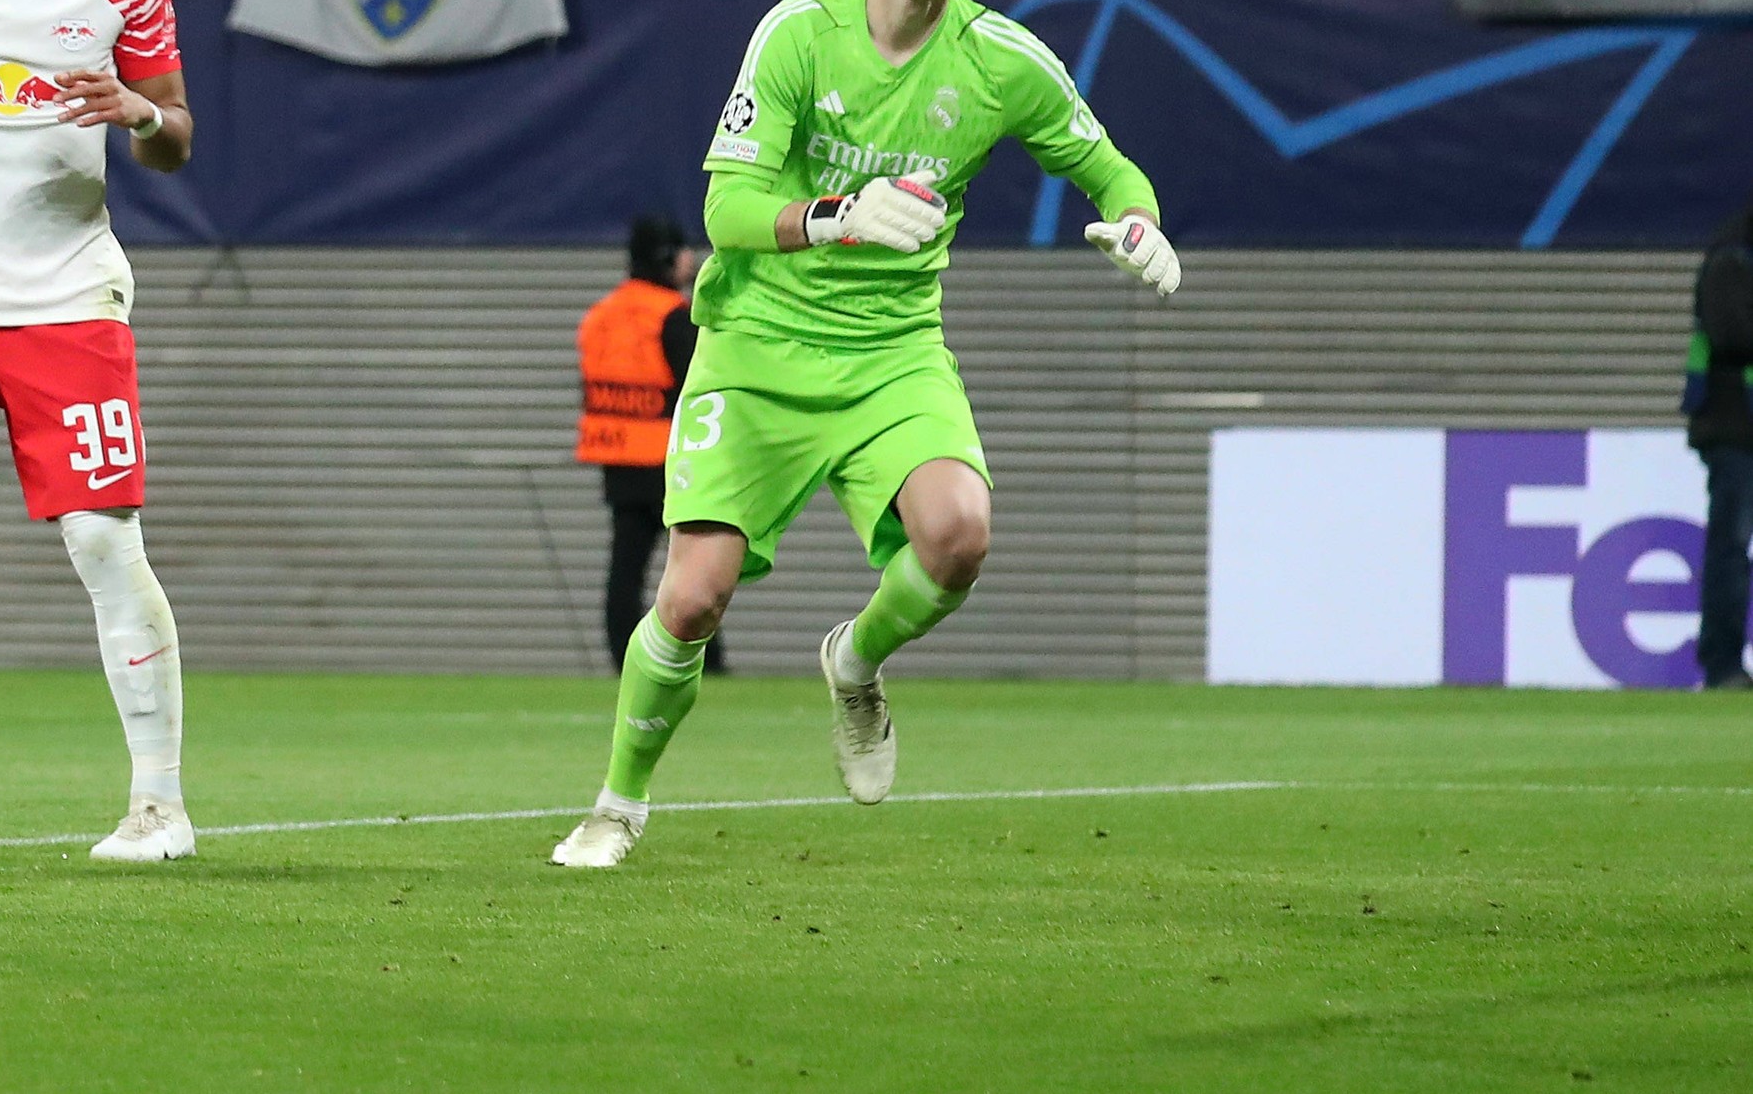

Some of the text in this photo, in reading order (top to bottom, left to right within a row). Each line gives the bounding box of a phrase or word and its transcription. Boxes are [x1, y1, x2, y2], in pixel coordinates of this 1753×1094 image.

[806, 131, 951, 181] Emirates
[62, 398, 138, 473] 39
[669, 391, 726, 455] 13
[1444, 430, 1753, 688] Fe
